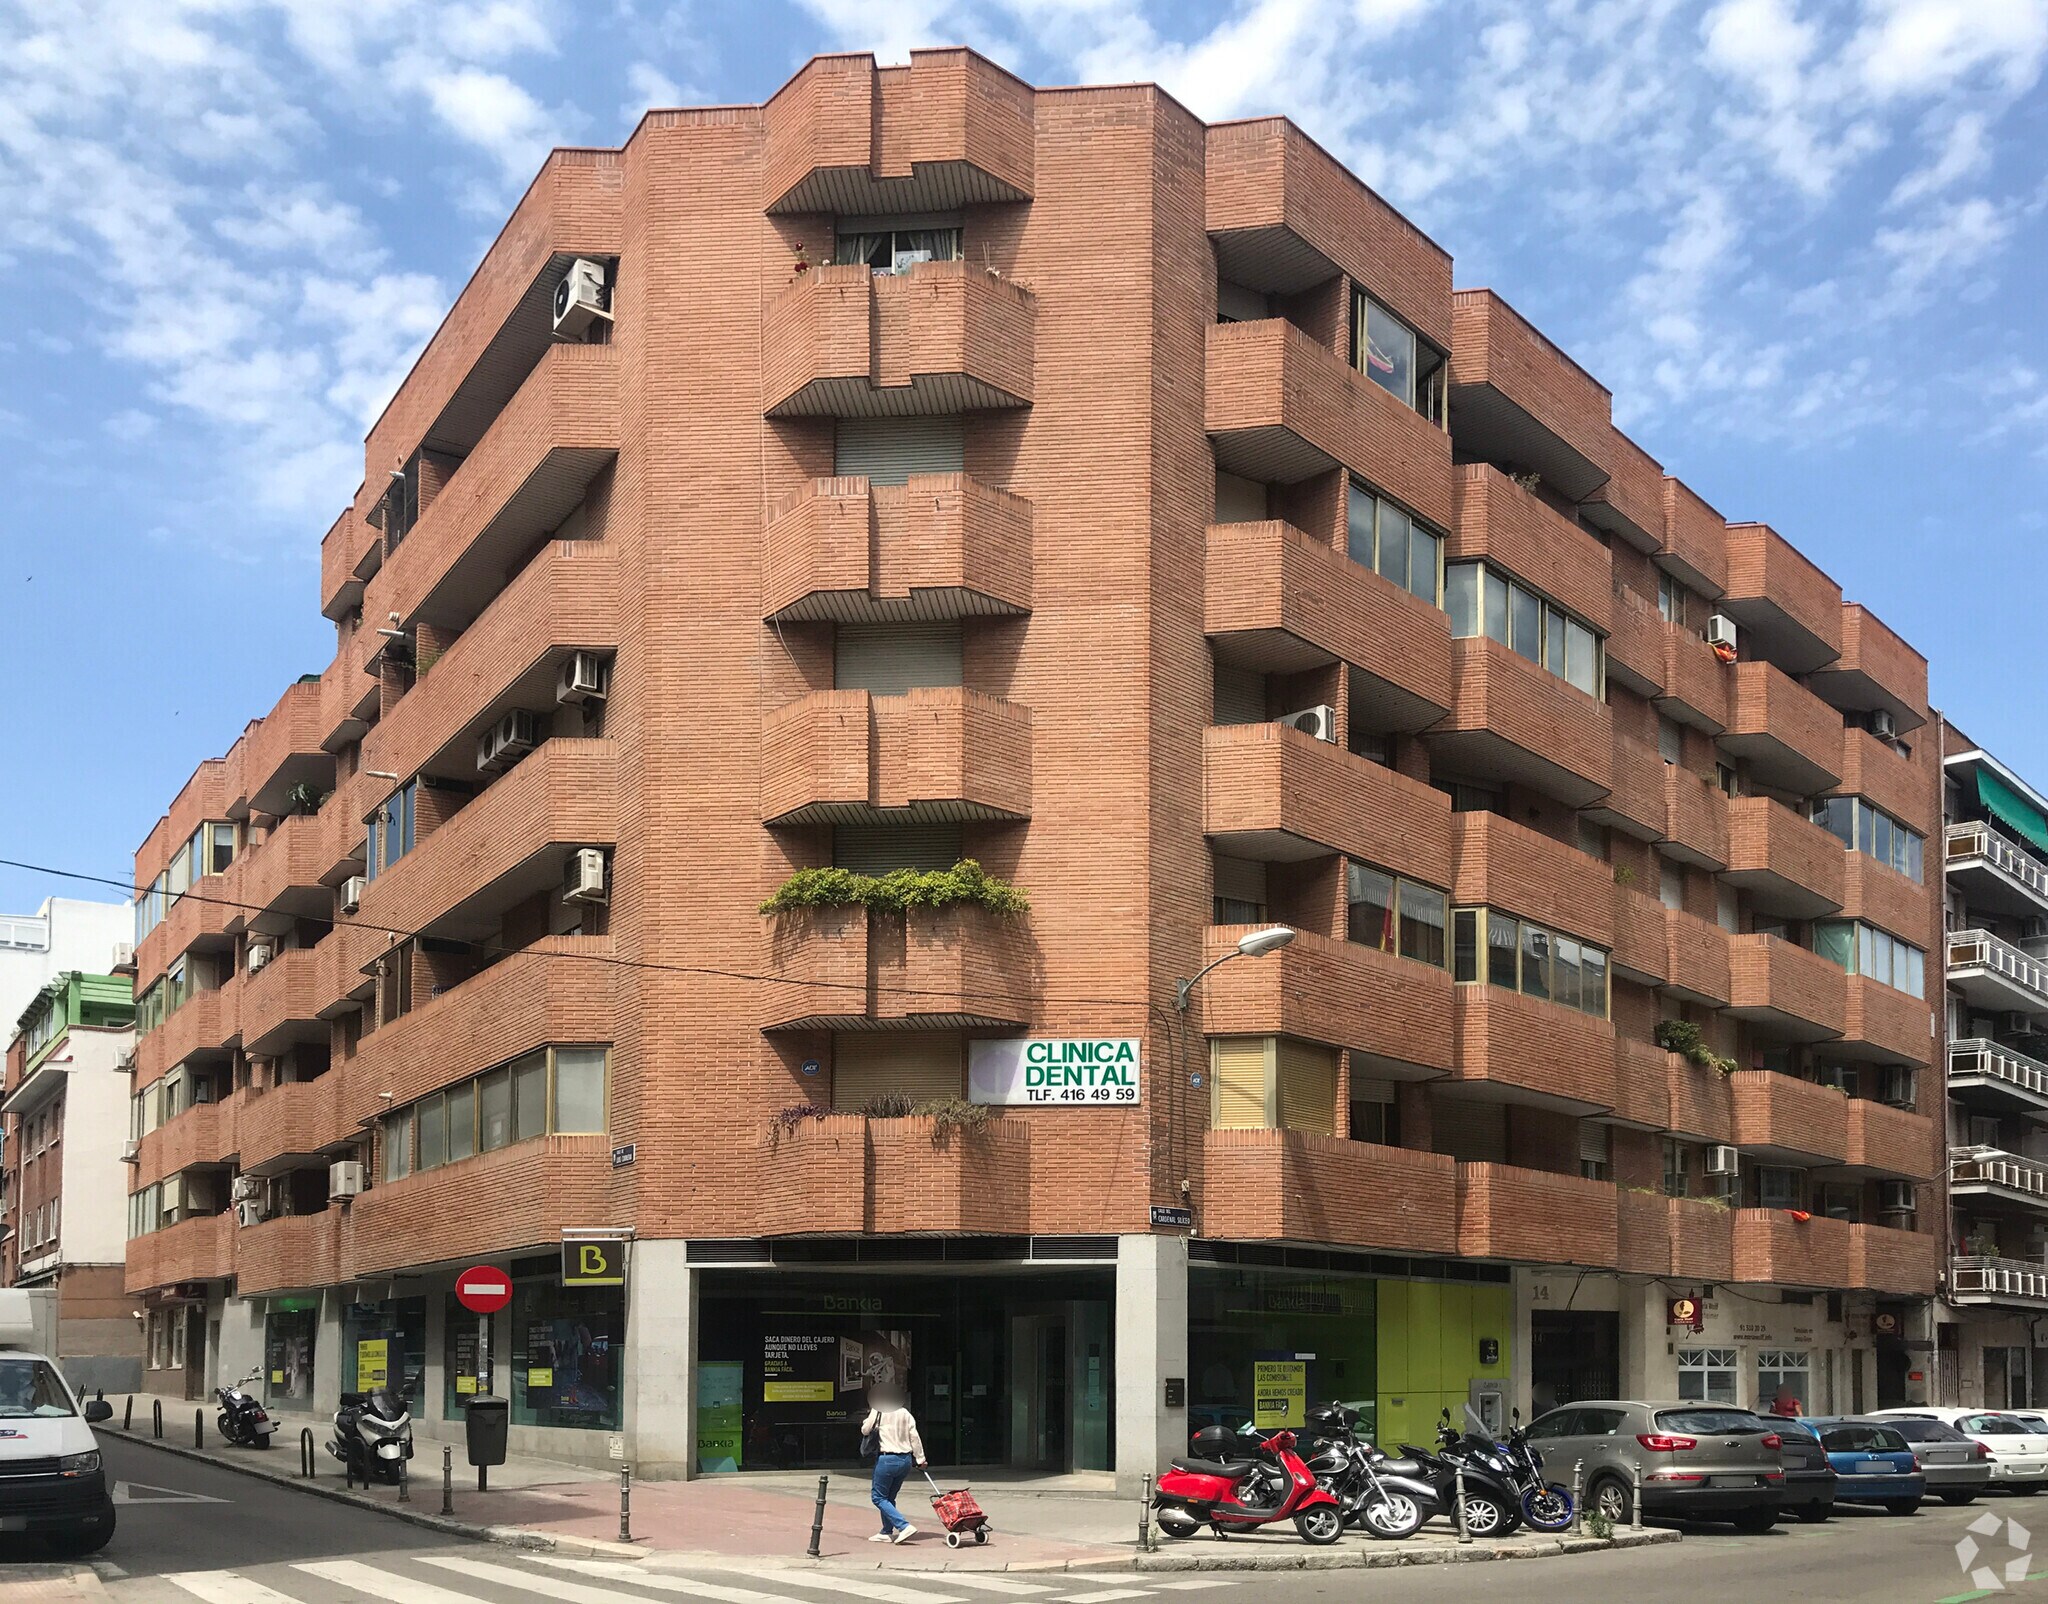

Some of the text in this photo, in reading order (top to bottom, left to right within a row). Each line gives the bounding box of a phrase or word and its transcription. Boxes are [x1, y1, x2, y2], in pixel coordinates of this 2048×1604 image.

[1026, 1041, 1135, 1064] CLINICA
[1025, 1065, 1136, 1087] DENTAL
[1026, 1087, 1135, 1101] TLF. 416 49 59
[580, 1245, 607, 1274] B
[1533, 1285, 1550, 1300] 14
[823, 1295, 883, 1311] Bankia
[764, 1335, 780, 1343] SACA
[780, 1335, 801, 1343] DINERO
[813, 1336, 835, 1344] CAJERO
[764, 1343, 818, 1351] AUNQUE NO LLEVES
[1257, 1364, 1277, 1373] PRIMERO
[1276, 1364, 1282, 1373] TE
[1257, 1373, 1266, 1382] LAS
[1257, 1388, 1272, 1397] AHORA
[1272, 1388, 1287, 1397] HEMOS
[697, 1439, 734, 1449] Bankia
